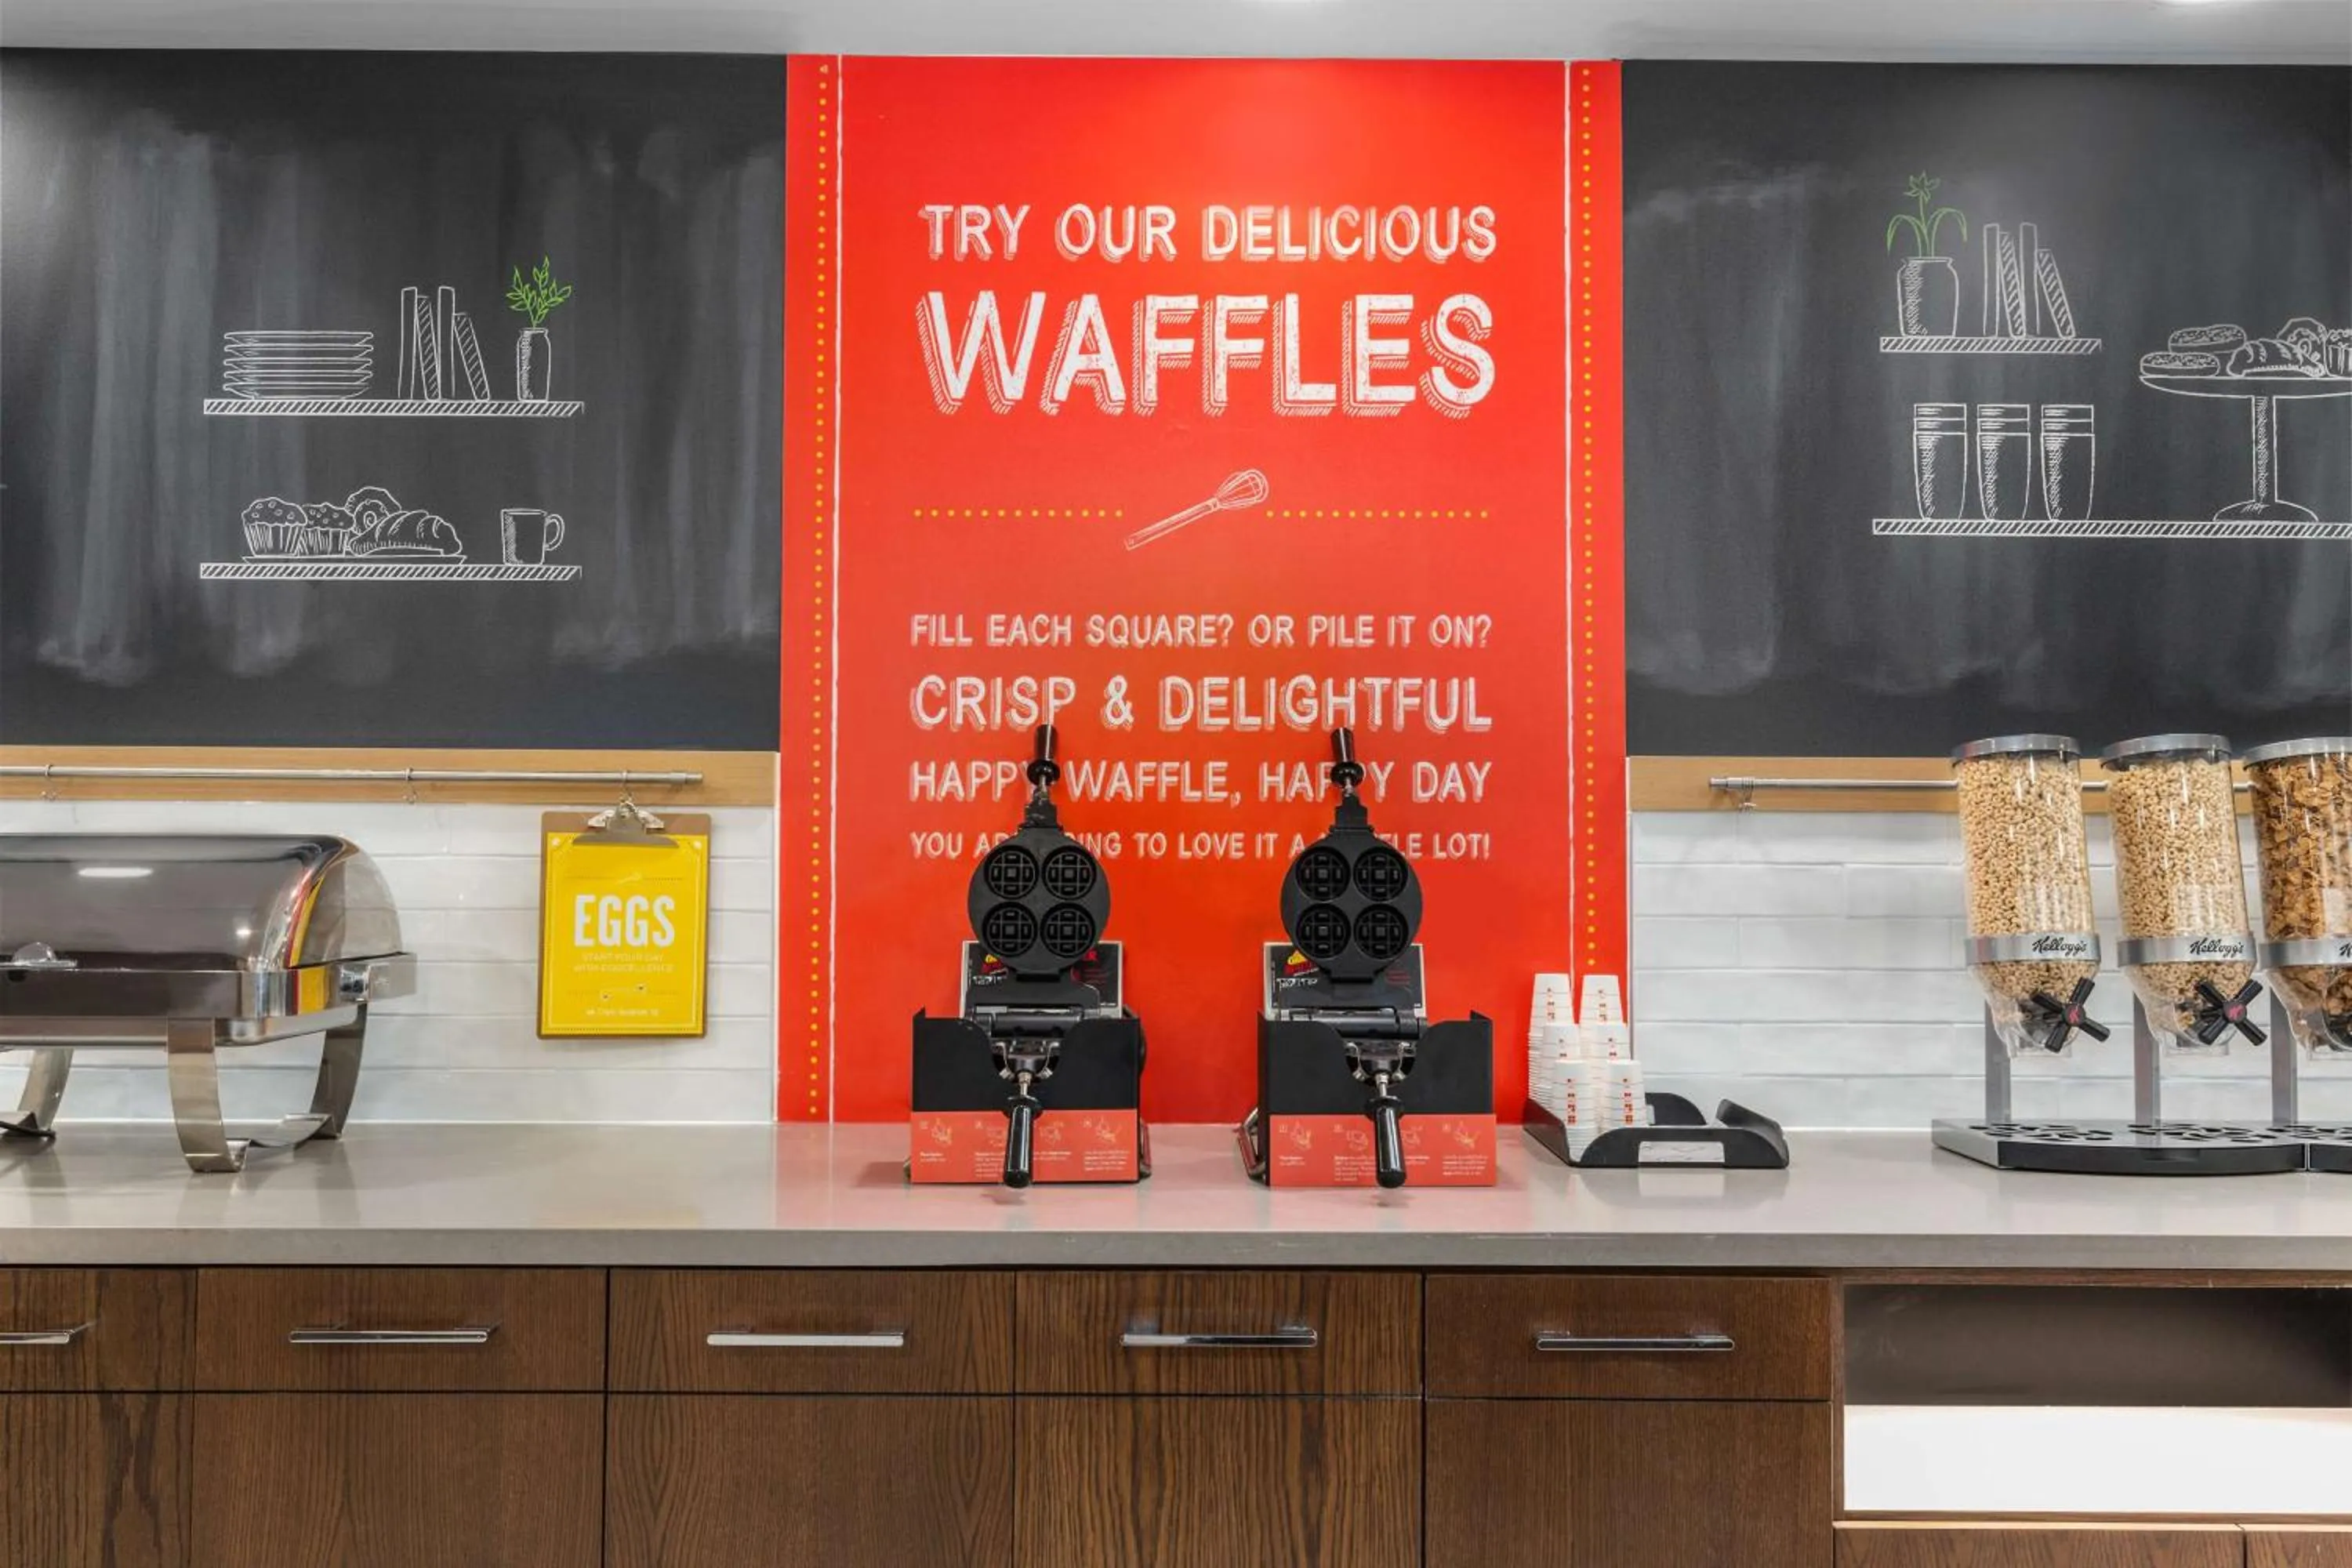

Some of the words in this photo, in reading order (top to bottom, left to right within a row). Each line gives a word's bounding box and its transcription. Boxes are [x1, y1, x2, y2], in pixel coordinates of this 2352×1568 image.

[918, 204, 1031, 262] TRY
[1055, 203, 1178, 263] OUR
[1203, 205, 1497, 264] DELICIOUS
[916, 290, 1497, 419] WAFFLES
[910, 614, 974, 647] FILL
[986, 614, 1073, 647] EACH
[1085, 614, 1235, 648] SQUARE?
[1248, 614, 1294, 648] OR
[1308, 615, 1376, 648] PILE
[1387, 615, 1417, 648] IT
[1429, 614, 1494, 648] ON?
[910, 674, 1076, 732] CRISP
[1101, 674, 1135, 732] &
[1160, 674, 1494, 734] DELIGHTFUL
[1064, 760, 1243, 808] WAFFLE,
[1259, 760, 1396, 804] HAPY
[1413, 761, 1494, 804] DAY
[910, 832, 964, 860] YOU
[1134, 832, 1169, 860] TO
[1178, 832, 1246, 860] LOVE
[1255, 833, 1279, 860] IT
[1288, 833, 1306, 860] A
[1432, 833, 1491, 861] LOT!
[575, 894, 676, 948] EGGS
[2032, 935, 2087, 956] Kellogg's
[2190, 937, 2244, 958] Kellogg's
